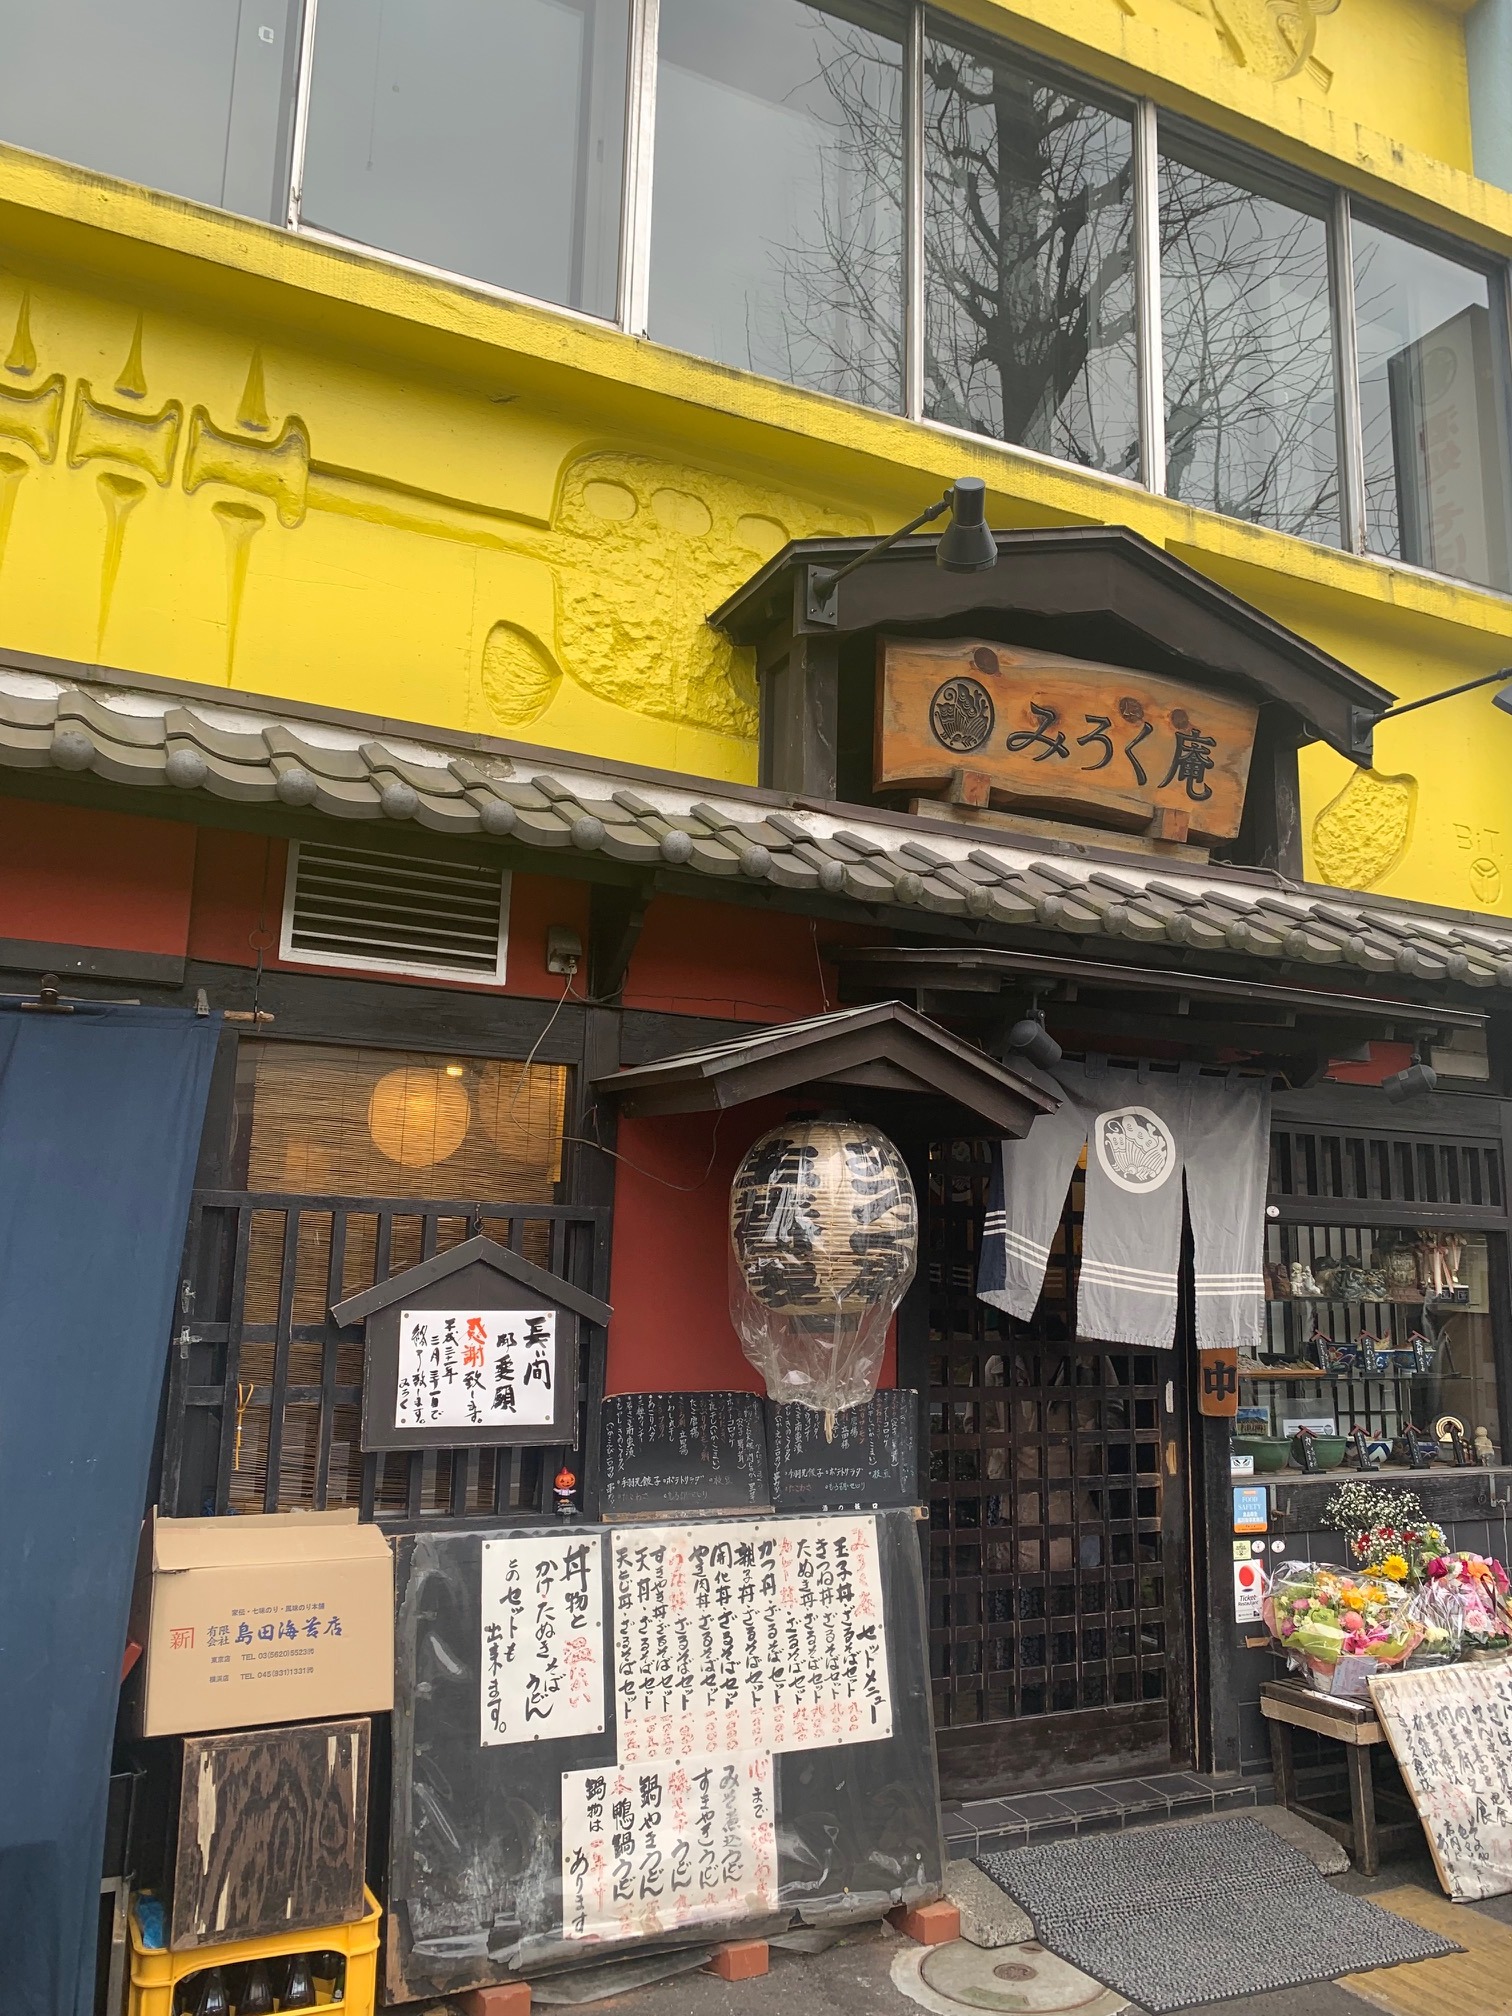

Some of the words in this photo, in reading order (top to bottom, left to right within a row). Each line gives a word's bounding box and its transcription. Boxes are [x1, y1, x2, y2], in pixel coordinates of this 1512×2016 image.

[1005, 701, 1217, 801] みろく庵
[523, 1316, 552, 1390] 長い間
[235, 1615, 344, 1646] 島田海苔店
[241, 1652, 256, 1662] TEL
[544, 1657, 567, 1692] そば
[240, 1671, 255, 1681] TEL
[526, 1673, 555, 1722] うどん
